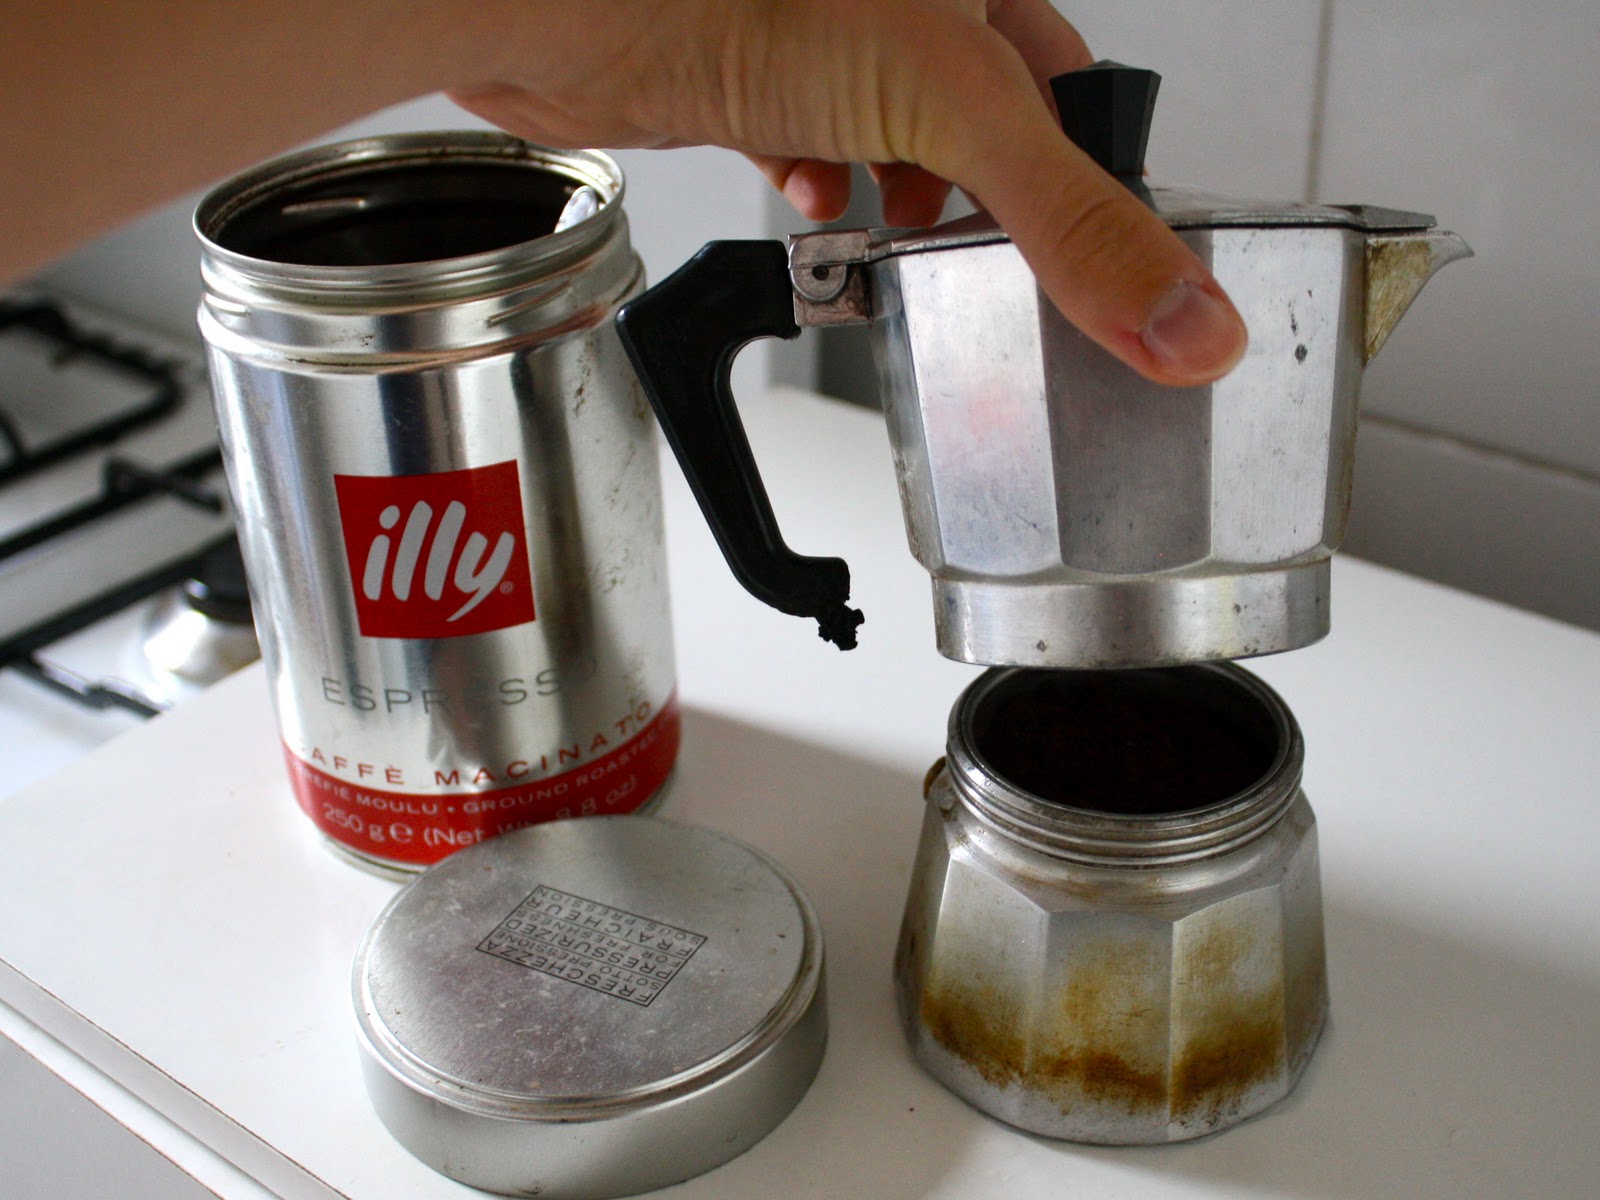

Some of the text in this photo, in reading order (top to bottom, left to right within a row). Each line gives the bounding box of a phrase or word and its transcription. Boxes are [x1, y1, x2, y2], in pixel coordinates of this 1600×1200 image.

[363, 500, 516, 622] illy
[310, 701, 651, 786] AFFÈ MACINATO
[323, 802, 365, 833] 250
[356, 793, 439, 815] MOULU
[463, 782, 569, 812] GROUND
[516, 909, 682, 968] FOR FRESHNESS
[525, 897, 693, 957] FRAICHEUR
[538, 888, 700, 945] SOUS PRESSION
[487, 940, 654, 1002] FRESCHEZZA
[495, 931, 662, 990] SOTTO PRESSIONE
[506, 919, 673, 980] PRESSURIZED
